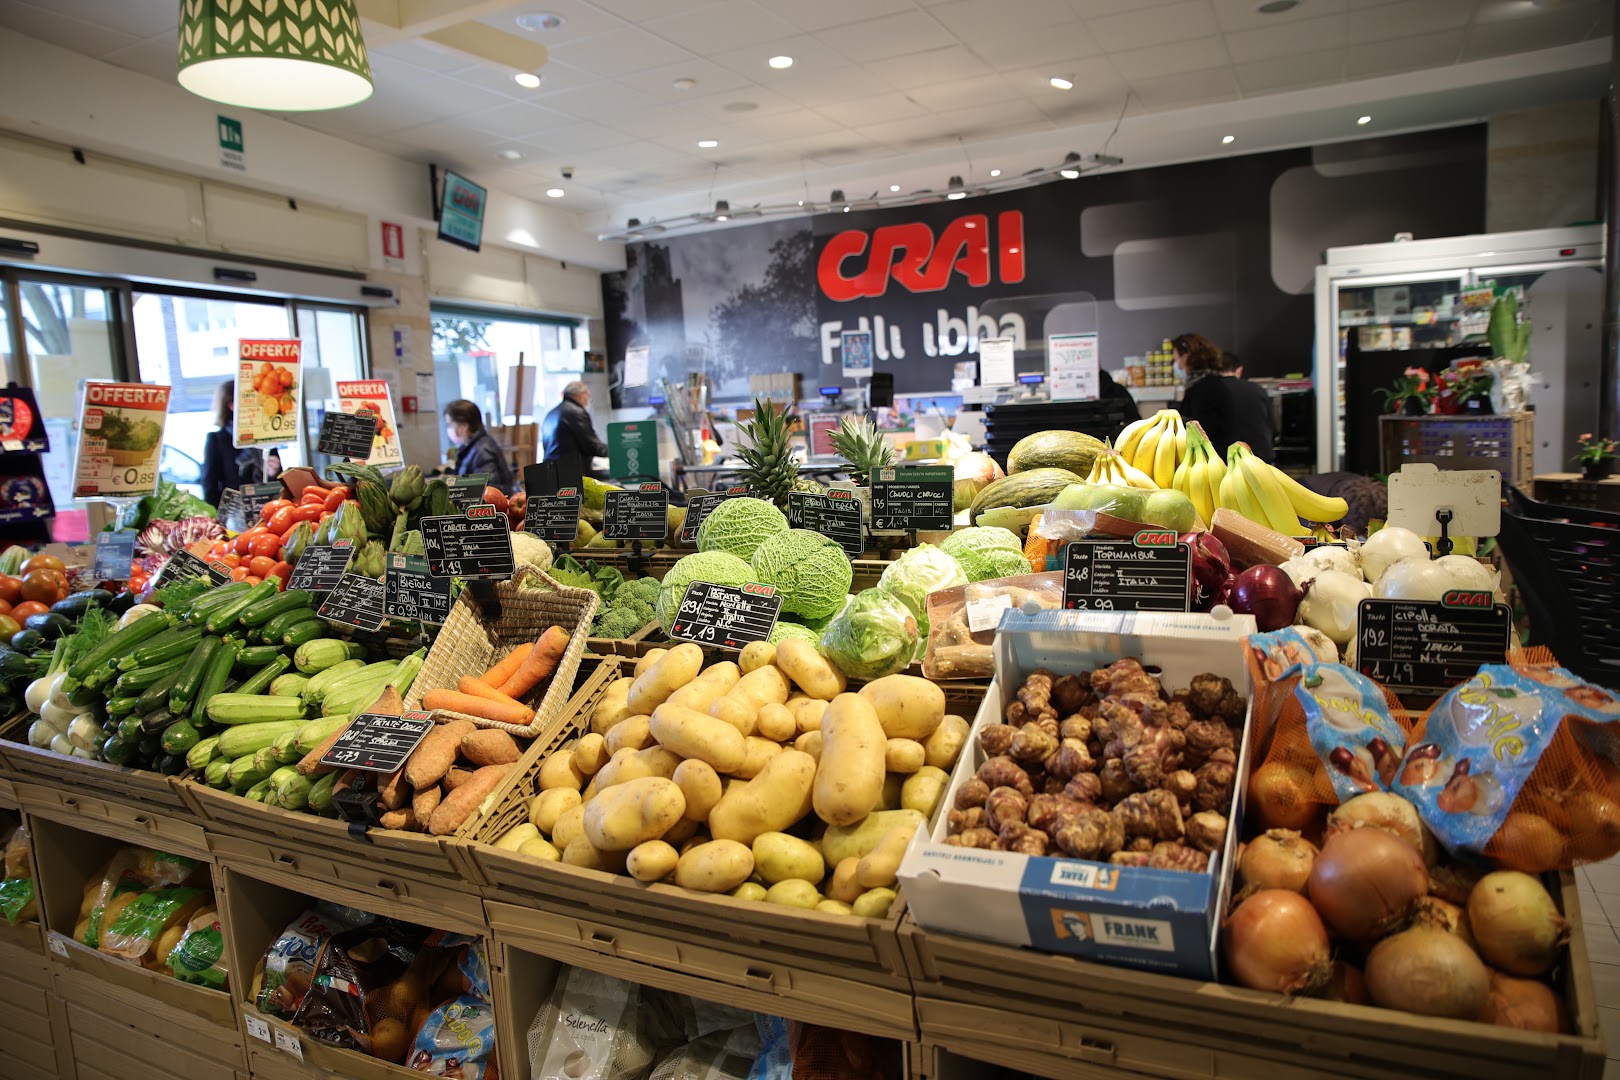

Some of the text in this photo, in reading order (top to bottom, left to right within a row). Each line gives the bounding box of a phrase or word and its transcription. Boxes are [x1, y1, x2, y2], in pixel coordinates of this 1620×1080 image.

[818, 210, 1026, 302] CRAI
[241, 344, 300, 357] OFFERTA
[88, 387, 167, 404] OFFERTA
[339, 384, 386, 396] OFFERTA
[271, 416, 296, 432] 0,99
[383, 445, 399, 458] 1,29
[124, 468, 154, 486] 0,89
[829, 490, 850, 500] CRAI
[468, 508, 494, 518] CRAI
[443, 524, 467, 532] CAROTE
[609, 524, 628, 537] 2,29
[876, 519, 884, 528] €
[1138, 534, 1174, 545] CRAI
[1095, 550, 1157, 560] TOPINAMBUR
[212, 562, 230, 576] CRAI
[439, 560, 462, 574] 1,19
[1067, 567, 1089, 581] 348
[387, 580, 397, 594] 69
[1118, 578, 1158, 586] ITALIA
[744, 583, 773, 596] CRAI
[1446, 592, 1490, 606] CRAI
[388, 605, 418, 617] € 0,99
[681, 600, 702, 615] 891
[675, 623, 715, 641] € 1,19
[1362, 628, 1388, 647] 192
[1418, 624, 1459, 633] DORATA
[1372, 661, 1413, 683] 1,49
[404, 712, 429, 720] CRAI
[1103, 921, 1159, 940] FRANK
[566, 1014, 608, 1034] Selenella
